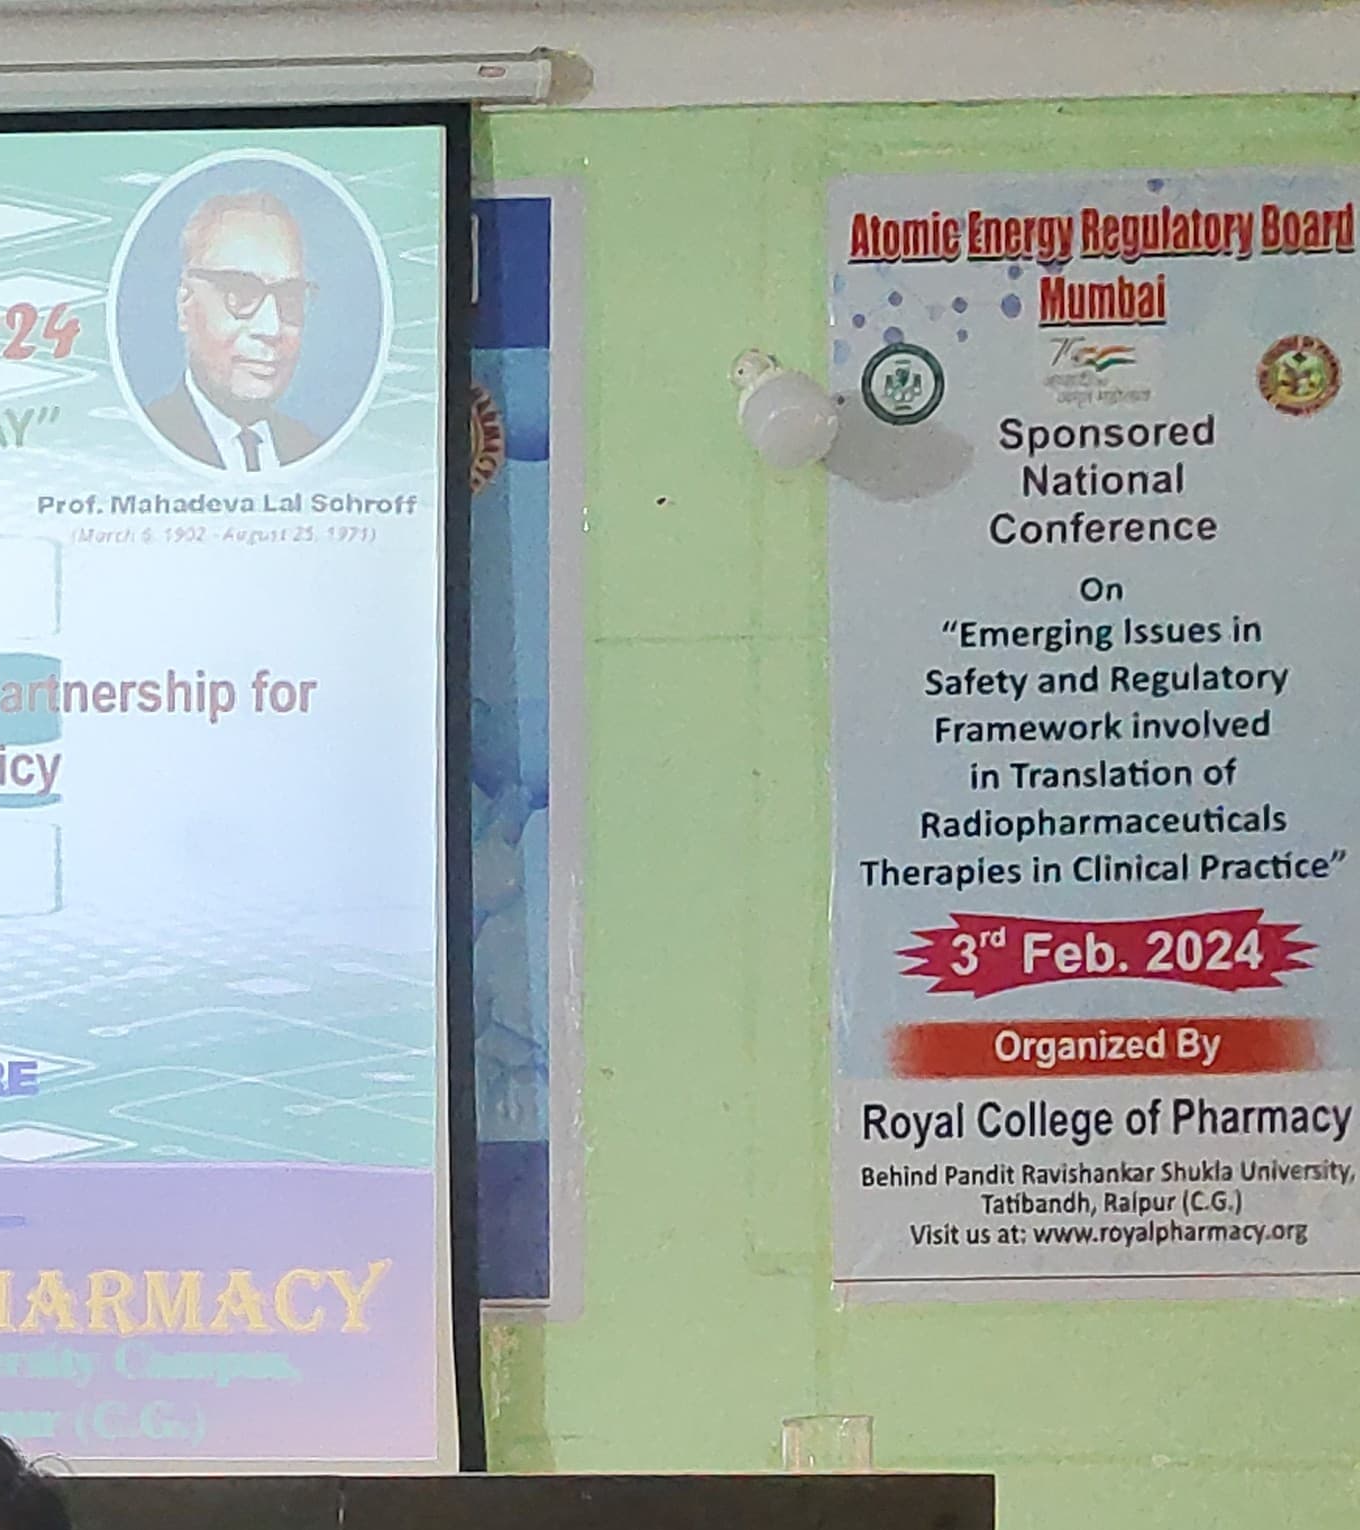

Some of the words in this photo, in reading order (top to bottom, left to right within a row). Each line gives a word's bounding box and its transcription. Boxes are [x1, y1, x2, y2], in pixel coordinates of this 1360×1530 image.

[850, 209, 962, 258] Atomic
[966, 209, 1073, 261] Energy
[1080, 205, 1254, 261] Regulatory
[1261, 202, 1356, 254] Board
[1039, 273, 1167, 323] Mumbai
[999, 415, 1216, 457] Sponsored
[1022, 463, 1185, 498] National
[37, 494, 102, 515] Prof.
[111, 493, 254, 514] Mahadeva
[263, 493, 302, 513] Lal
[989, 511, 1218, 546] Conference
[252, 669, 317, 713] for
[863, 1103, 964, 1148] Royal
[977, 1101, 1113, 1146] College
[1125, 1099, 1161, 1137] of
[1172, 1097, 1352, 1143] Pharmacy
[862, 1164, 938, 1187] Behind
[945, 1163, 1015, 1187] Pandit
[1022, 1162, 1154, 1186] Ravishankar
[1161, 1160, 1233, 1184] Shukla
[1240, 1158, 1357, 1186] University,
